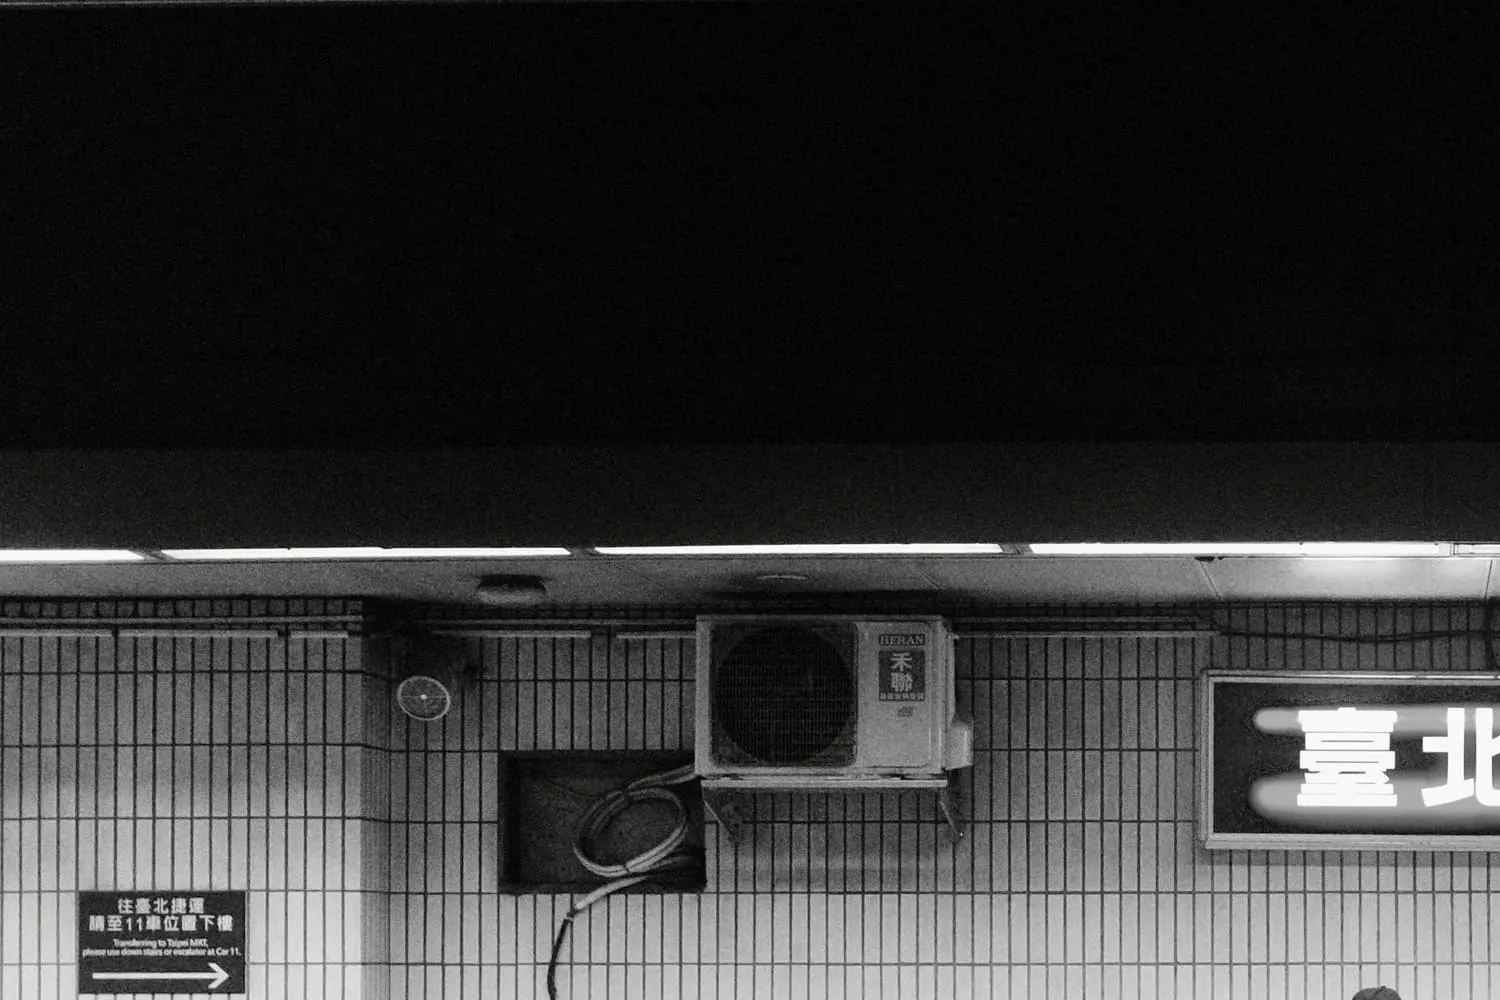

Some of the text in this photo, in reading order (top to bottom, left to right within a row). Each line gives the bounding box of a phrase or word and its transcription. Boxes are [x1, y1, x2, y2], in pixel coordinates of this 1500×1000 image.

[880, 635, 924, 645] HERAN
[890, 652, 913, 692] 禾聯
[117, 897, 205, 914] 往臺北捷運
[89, 914, 233, 932] 請至11車位置下樓
[113, 938, 157, 949] Transferring
[158, 939, 166, 947] to
[167, 938, 188, 948] Taipei
[106, 948, 120, 956] use
[120, 947, 142, 956] down
[164, 948, 173, 956] or
[216, 947, 229, 956] Car
